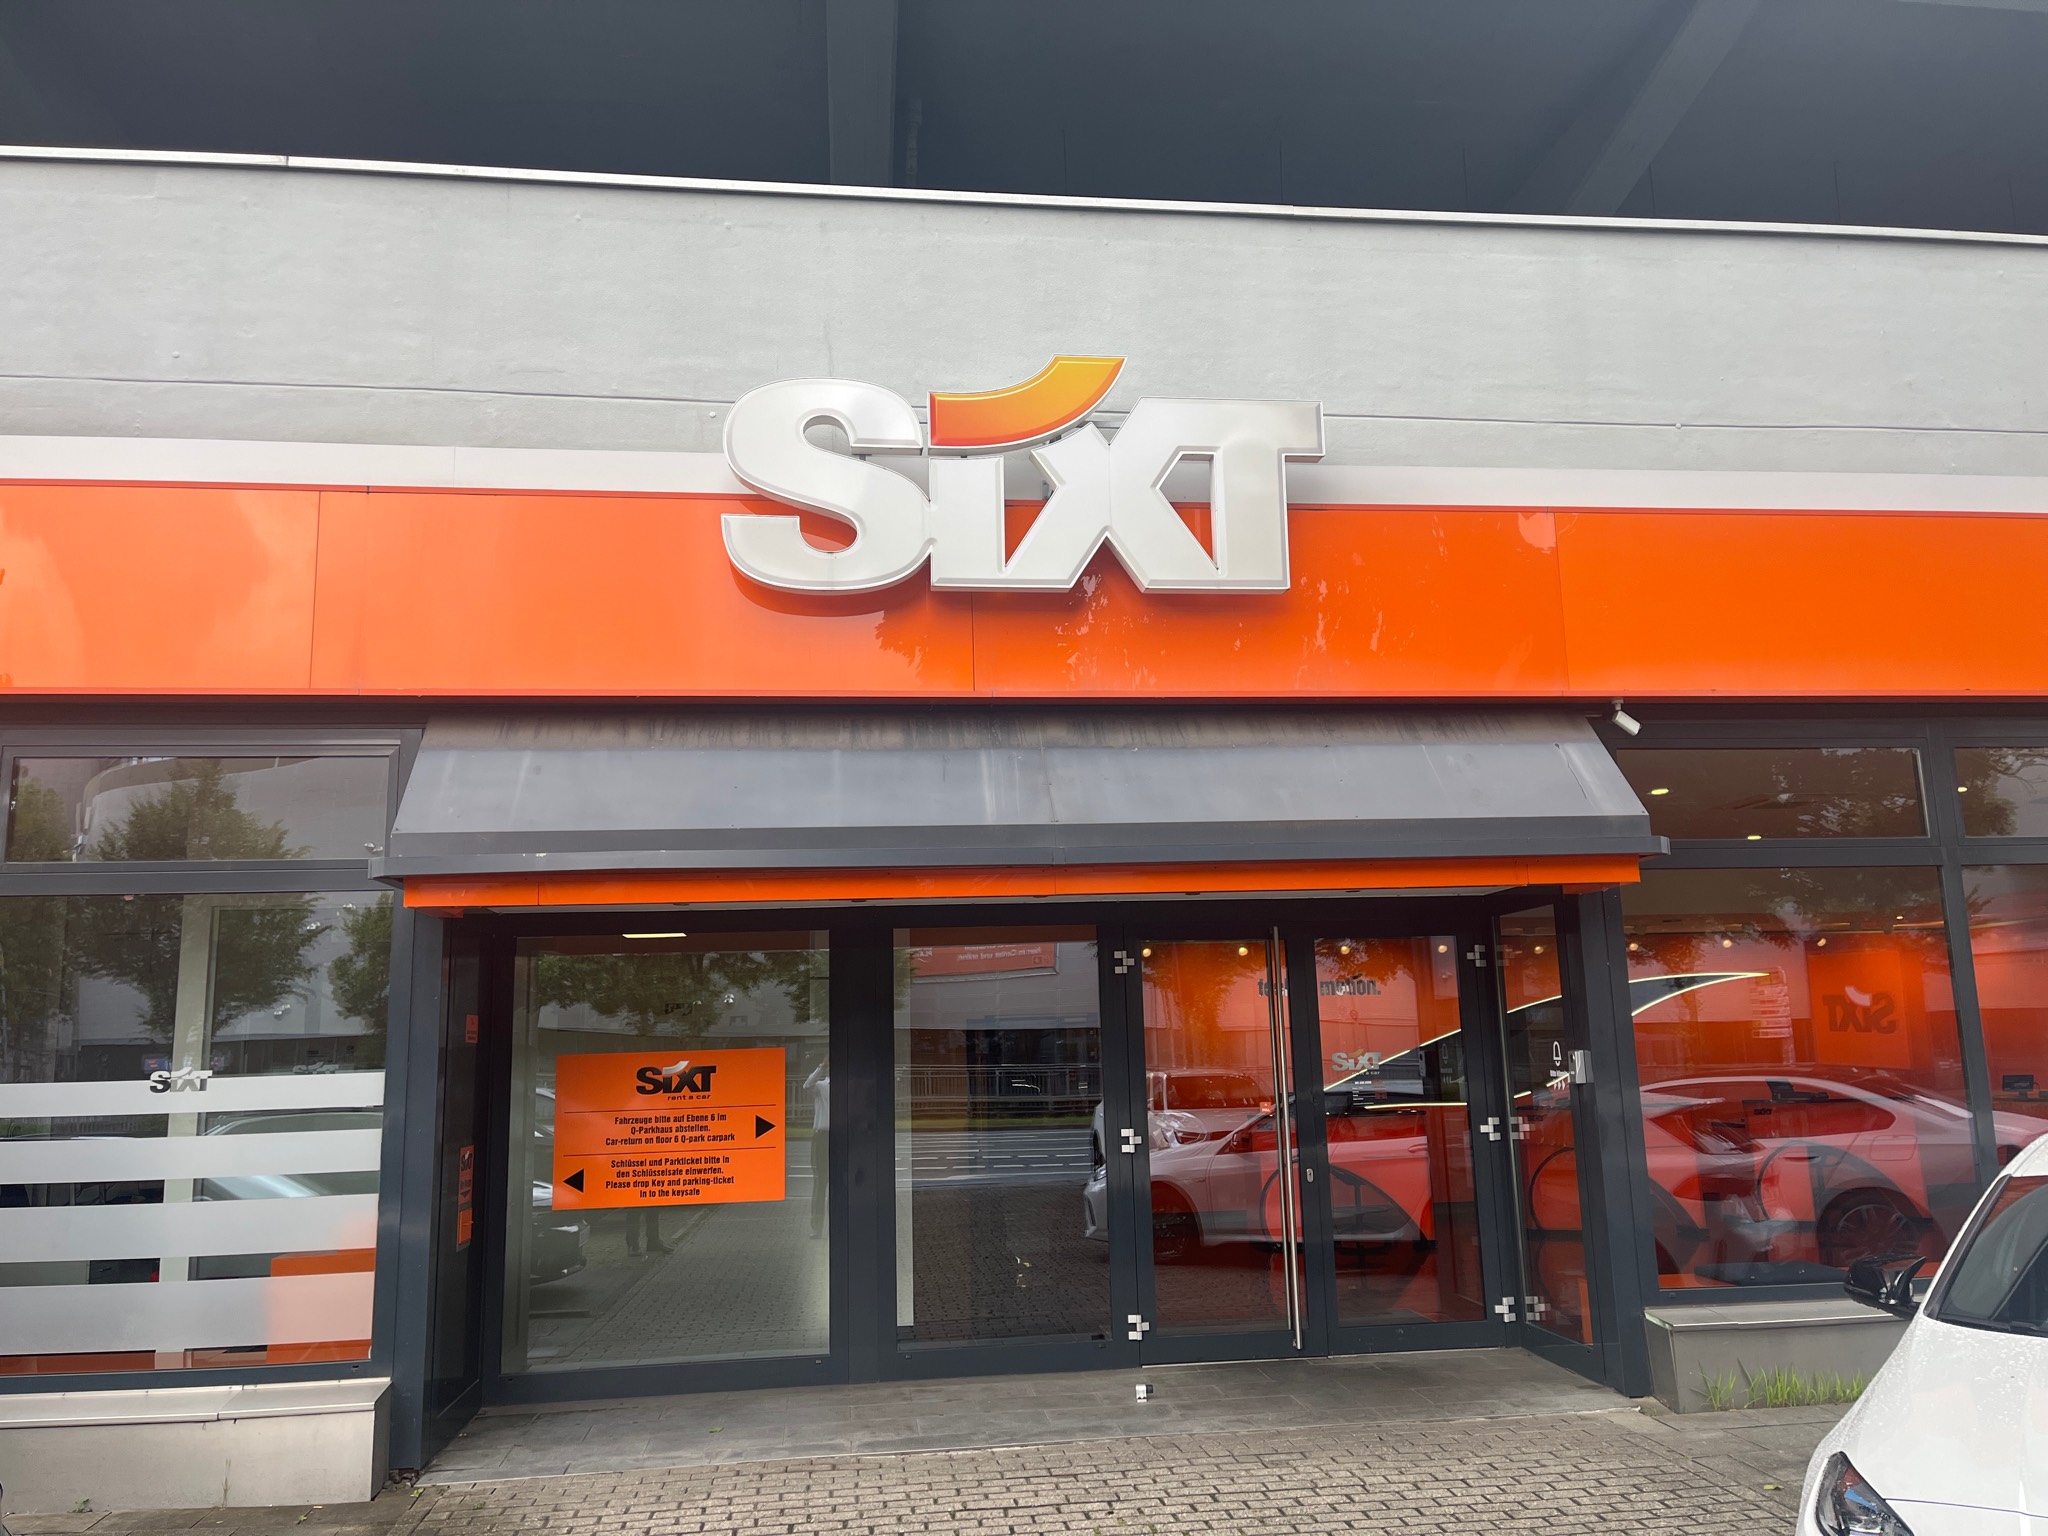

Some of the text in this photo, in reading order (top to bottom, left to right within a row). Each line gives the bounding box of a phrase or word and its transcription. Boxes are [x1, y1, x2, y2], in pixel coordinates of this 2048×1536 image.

[721, 354, 1326, 593] SIXT
[1332, 1048, 1382, 1072] SIXT
[150, 1067, 213, 1093] SIXT
[636, 1060, 717, 1095] SIXT
[614, 1112, 727, 1125] Fahrzeuge bitte auf Ebene 6 im
[630, 1123, 711, 1135] Q-Parkhaus abstellen.
[605, 1136, 643, 1146] Car-return
[655, 1134, 673, 1144] floor
[673, 1134, 679, 1143] 6
[680, 1132, 706, 1144] Q-park
[707, 1132, 736, 1143] carpark
[611, 1155, 730, 1169] Schlüssel und Parkticket bitte in
[616, 1166, 724, 1178] den Schlüsselsafe einwerfen.
[605, 1175, 735, 1189] Please drop Key and parking-ticket
[648, 1189, 657, 1197] to
[658, 1188, 670, 1197] the
[671, 1187, 701, 1197] keysafe
